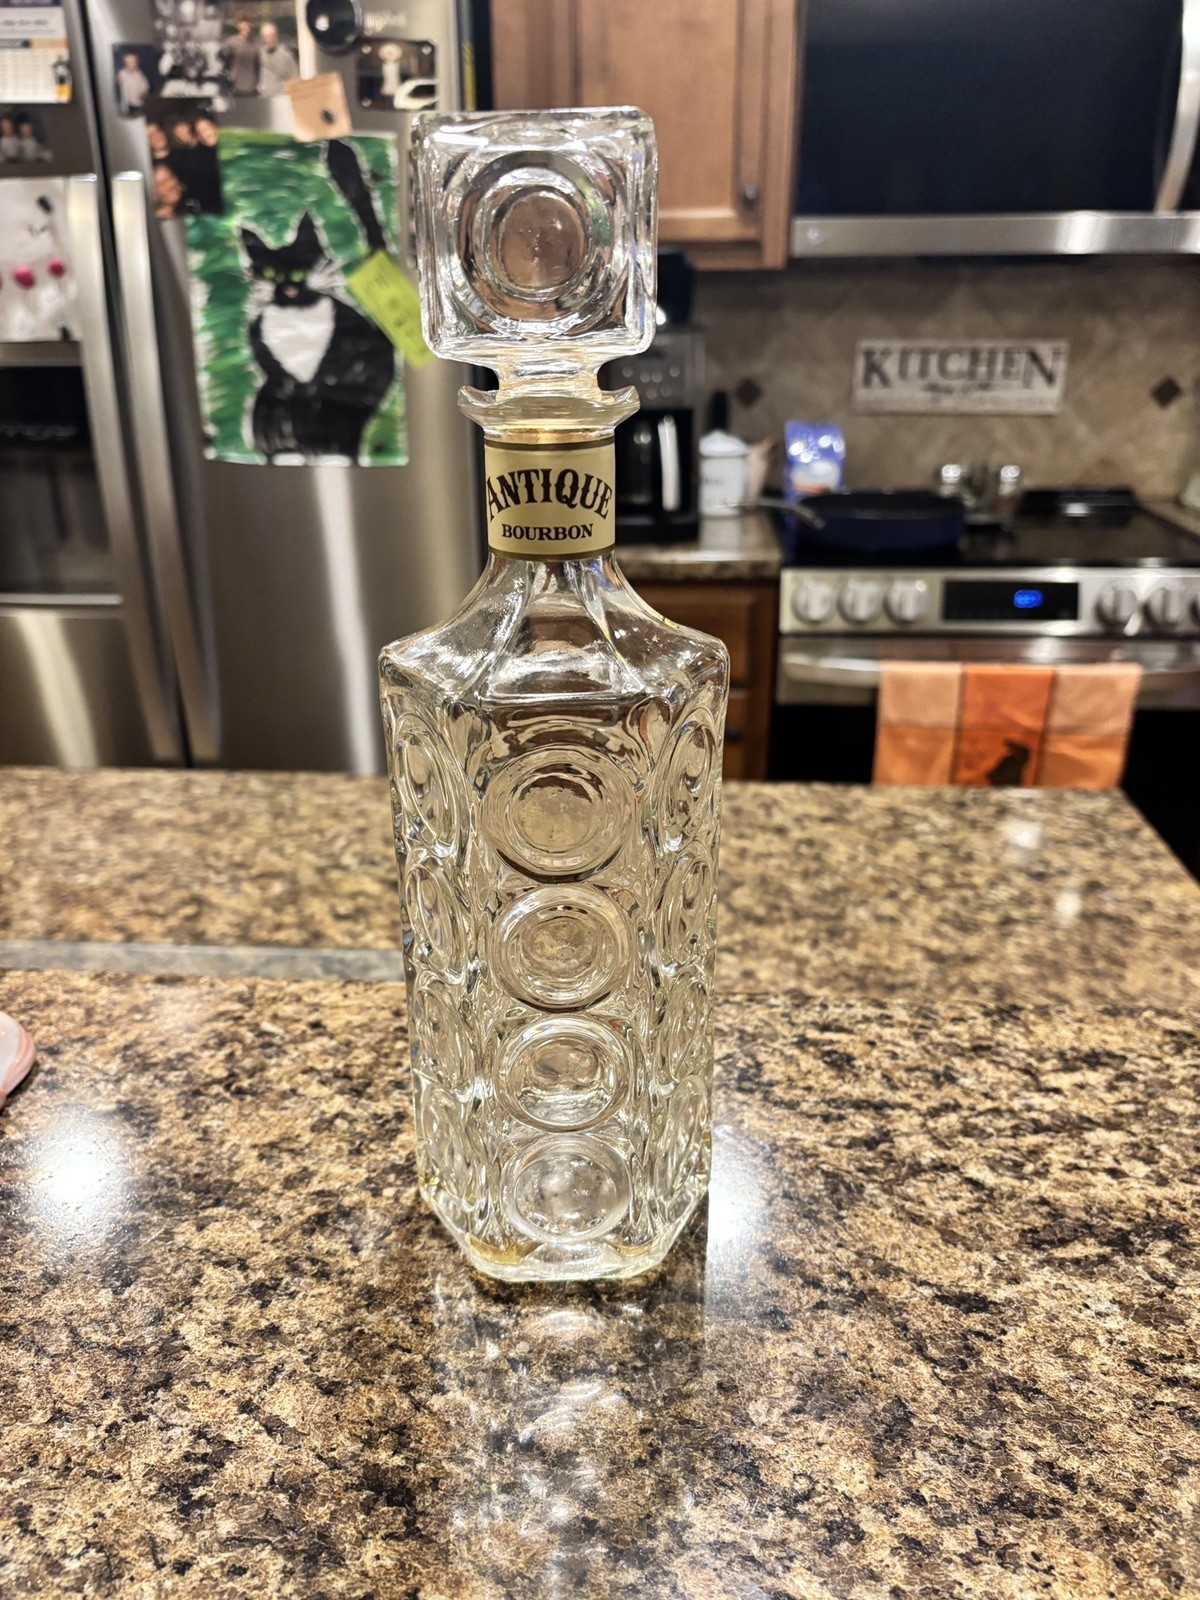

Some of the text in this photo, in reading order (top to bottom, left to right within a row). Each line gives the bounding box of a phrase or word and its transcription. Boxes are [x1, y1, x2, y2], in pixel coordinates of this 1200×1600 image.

[862, 347, 1065, 389] KITCHEN
[486, 468, 613, 522] ANTIQUE
[501, 523, 594, 541] BOURBON
